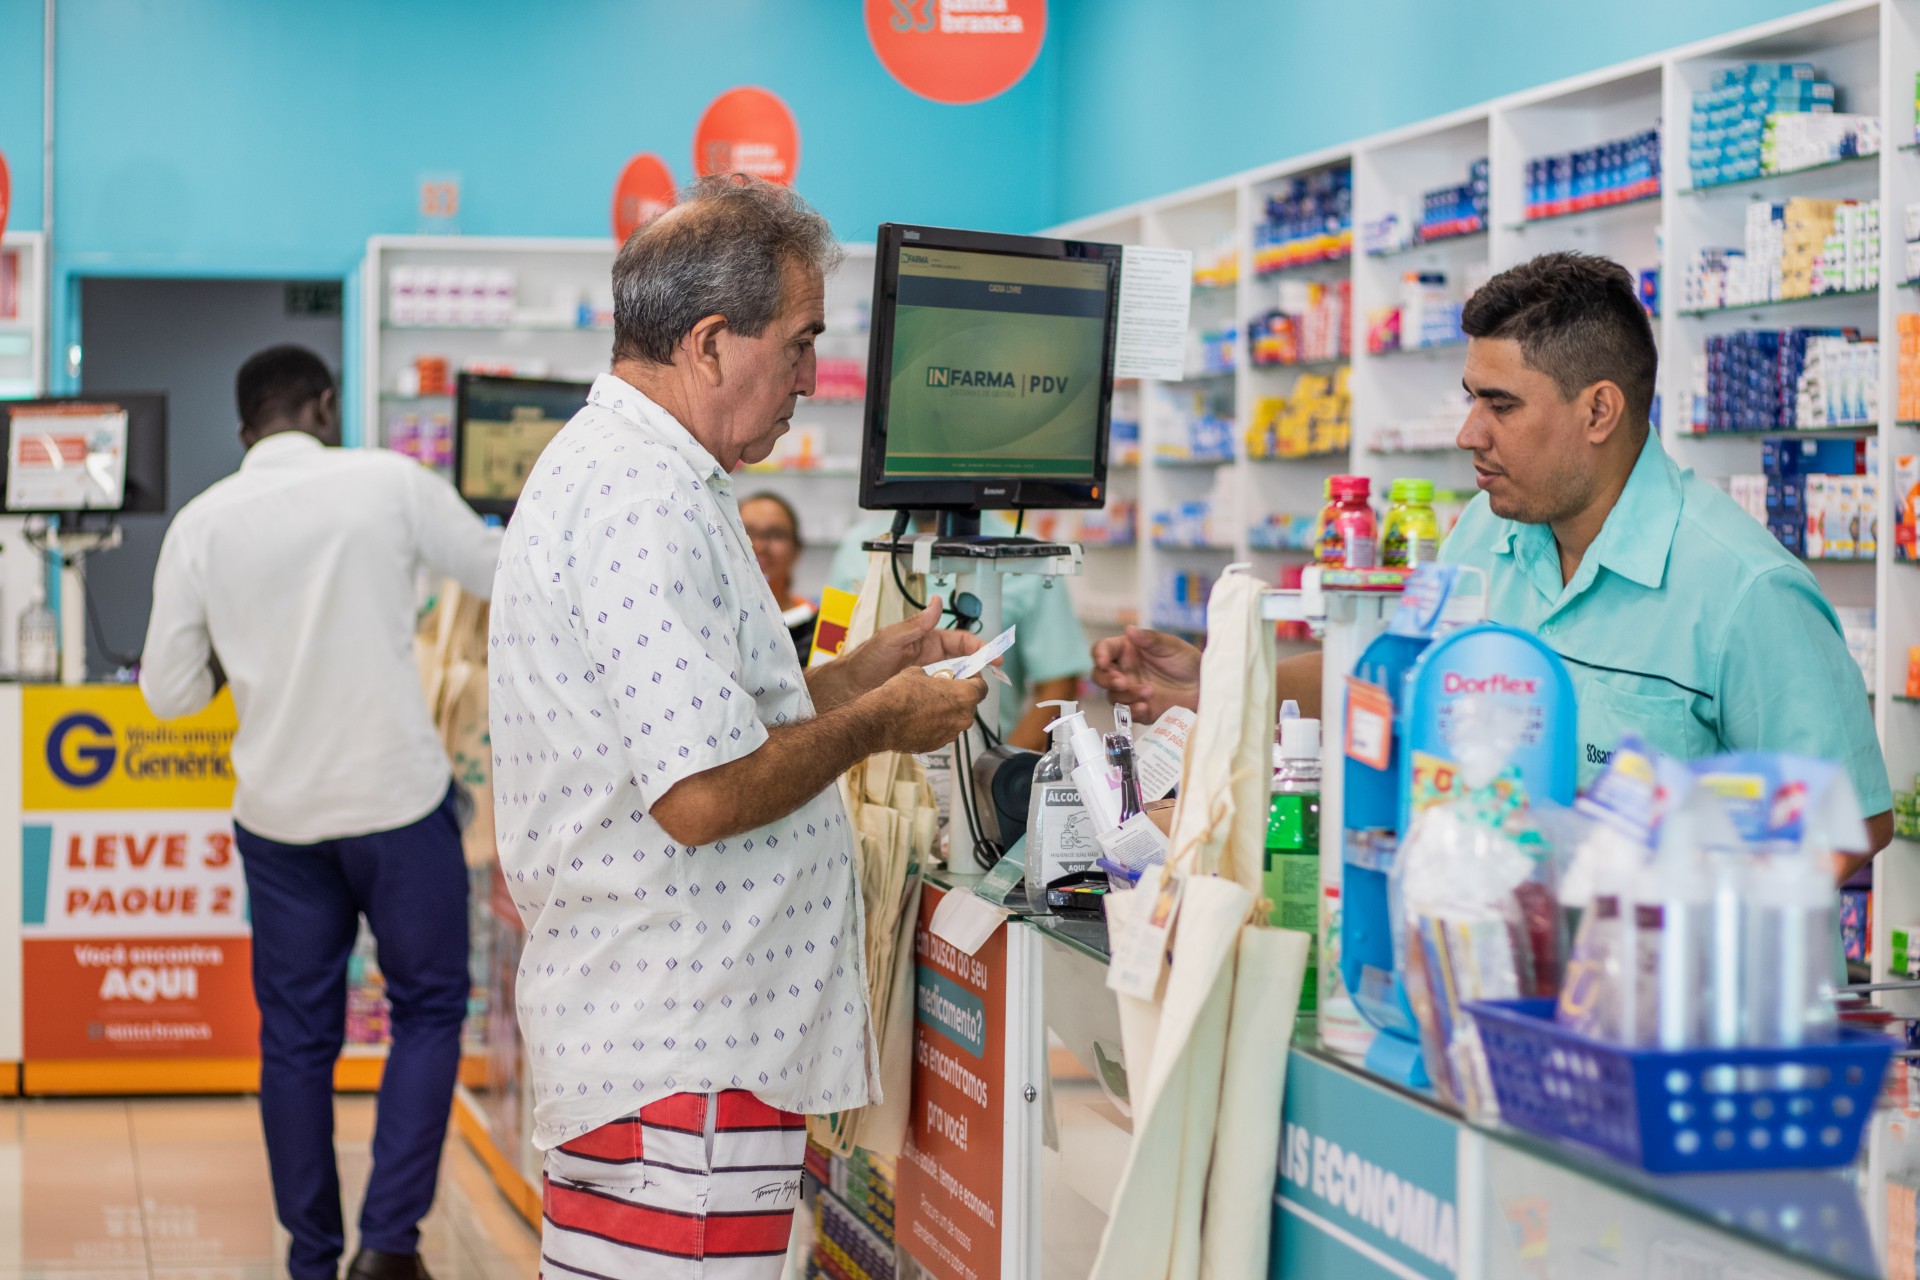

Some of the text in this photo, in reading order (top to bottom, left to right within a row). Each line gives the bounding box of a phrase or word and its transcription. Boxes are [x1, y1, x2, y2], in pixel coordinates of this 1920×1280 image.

[940, 13, 1024, 33] branca
[928, 367, 1069, 394] INFARMA PDV
[1444, 672, 1537, 693] Dorflex
[46, 712, 117, 789] G
[1047, 790, 1081, 802] ÁLCOO
[68, 833, 231, 869] LEVE 3
[1068, 864, 1085, 872] AQUI
[212, 887, 232, 914] 2
[74, 943, 222, 966] Você encontra
[930, 934, 956, 973] busca
[971, 958, 988, 991] seu
[99, 968, 198, 1002] AQUI
[918, 984, 983, 1046] medicamento?
[929, 1047, 988, 1109] encontramos
[927, 1100, 968, 1152] pra você!
[751, 1182, 782, 1205] Tommy
[939, 1164, 958, 1199] tempo
[963, 1188, 996, 1230] economia.
[1311, 1136, 1457, 1272] ECONOMIA
[954, 1230, 972, 1252] nossos
